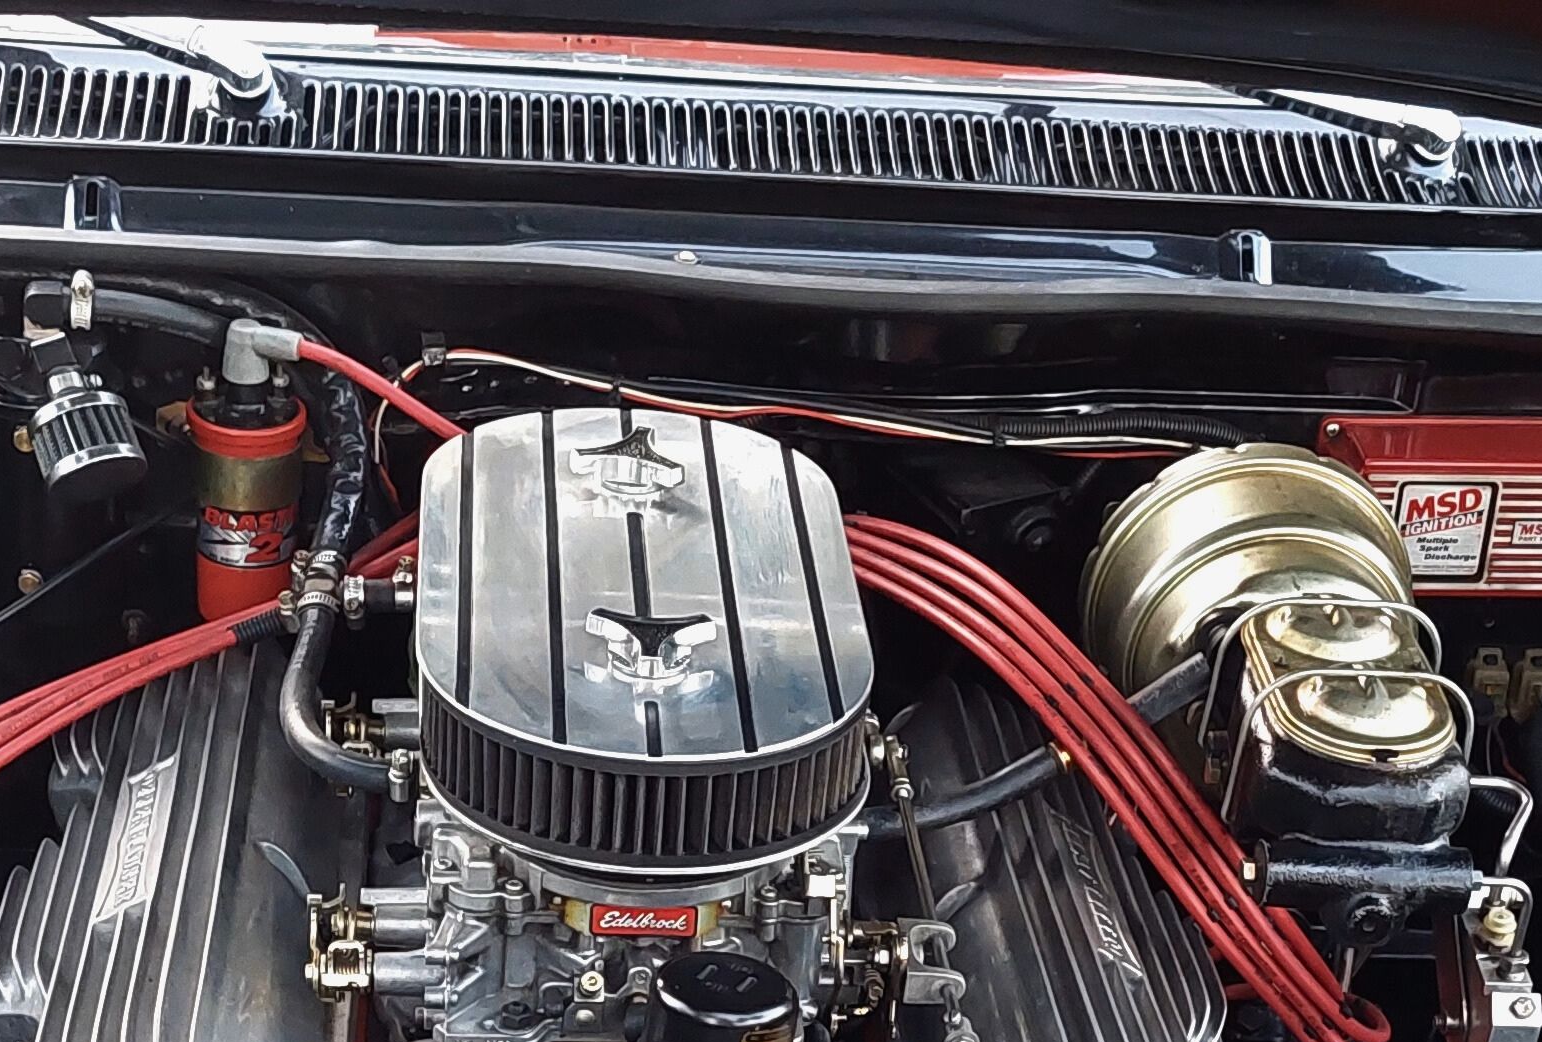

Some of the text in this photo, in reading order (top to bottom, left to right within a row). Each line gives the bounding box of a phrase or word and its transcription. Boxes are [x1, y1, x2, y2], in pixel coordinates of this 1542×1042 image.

[1405, 488, 1483, 523] MSD
[1404, 512, 1478, 536] IGNITION
[245, 532, 283, 564] 2
[1424, 553, 1477, 562] Discharge
[600, 911, 687, 931] Edelbrock
